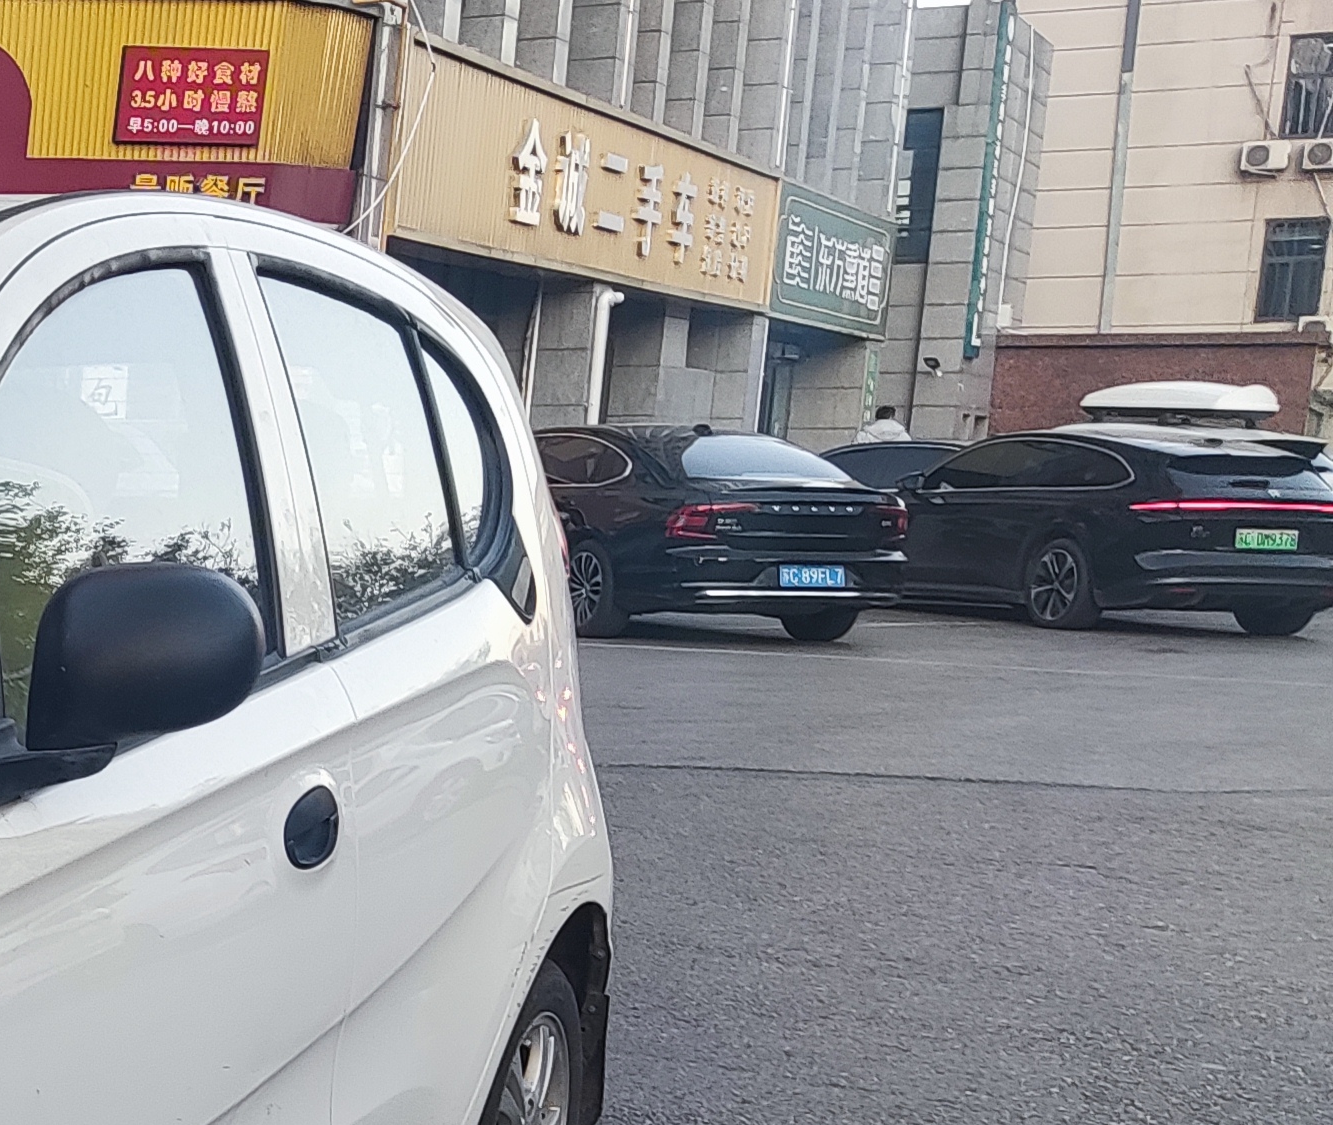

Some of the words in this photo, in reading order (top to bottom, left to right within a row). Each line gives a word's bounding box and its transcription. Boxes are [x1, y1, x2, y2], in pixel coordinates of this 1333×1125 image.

[134, 60, 261, 85] 八种好食材
